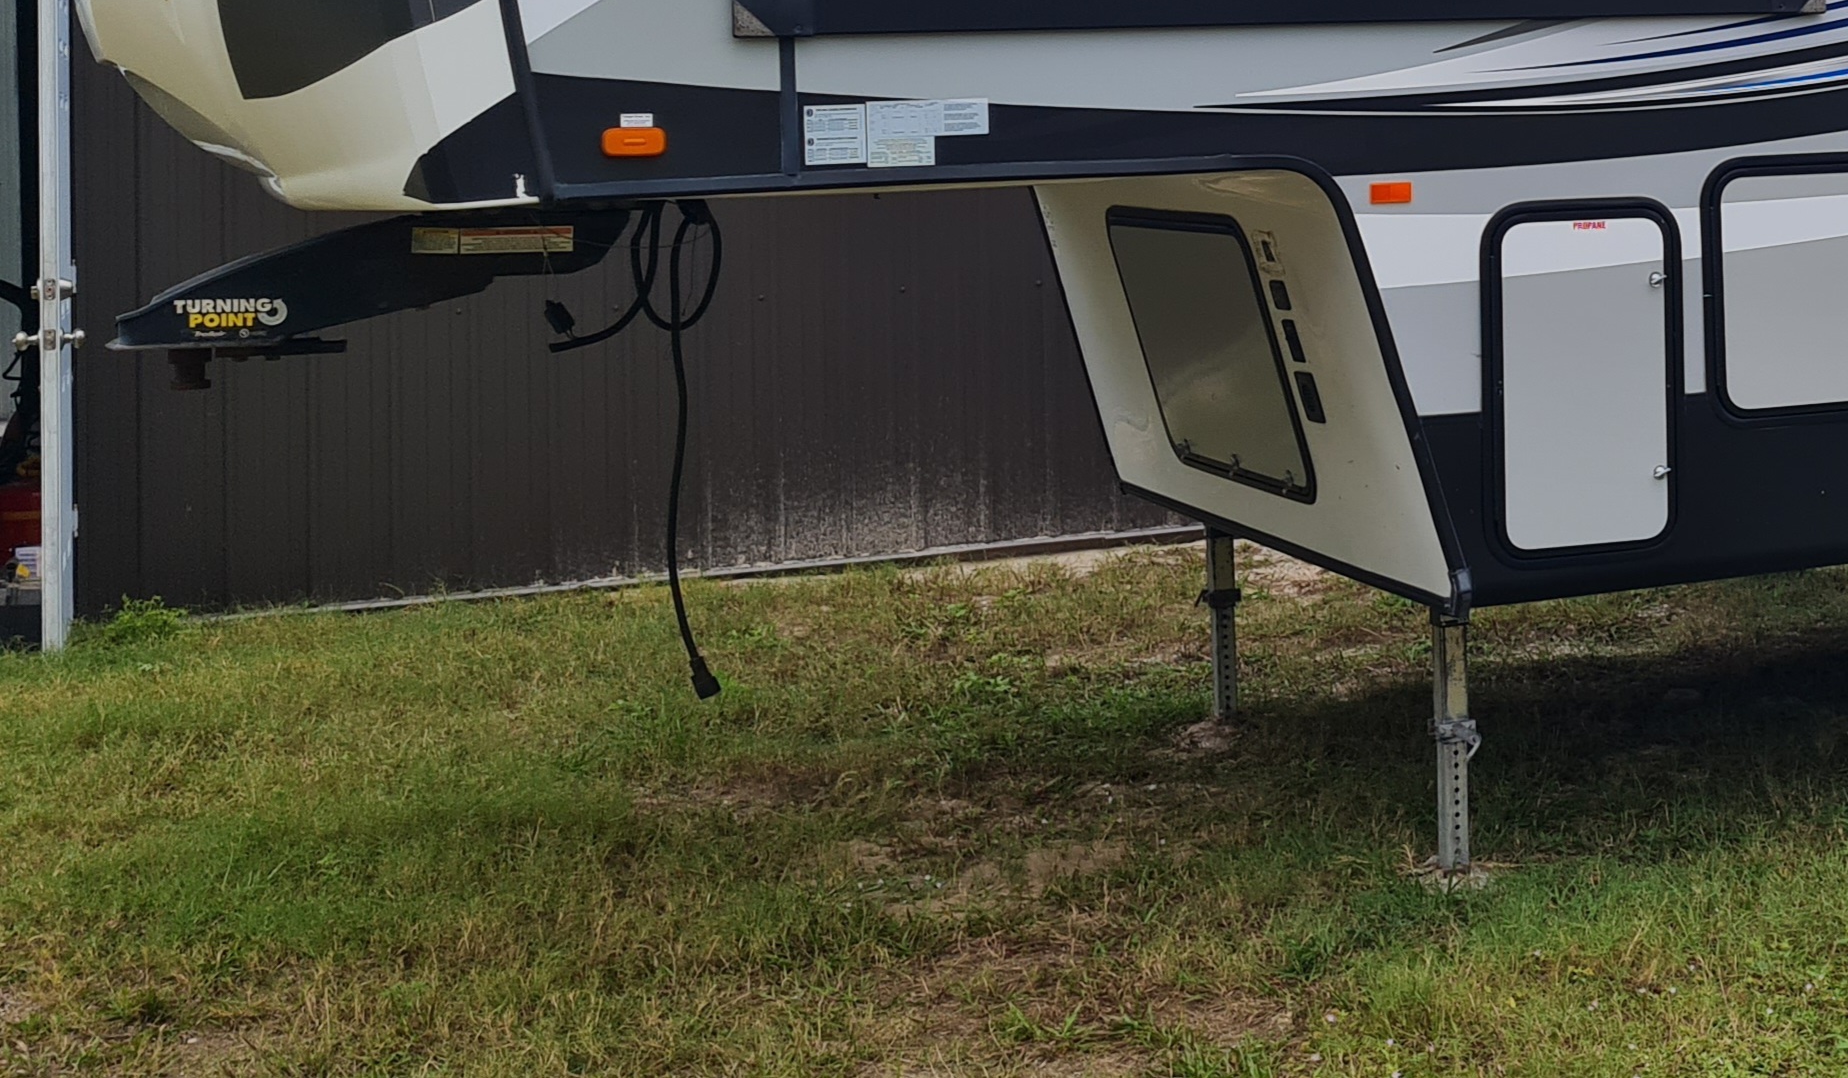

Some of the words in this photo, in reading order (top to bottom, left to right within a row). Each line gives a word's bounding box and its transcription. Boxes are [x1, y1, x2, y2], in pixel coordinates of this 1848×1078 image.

[1573, 221, 1606, 230] PROPANE
[173, 297, 272, 314] TURNING
[189, 312, 256, 328] POINT
